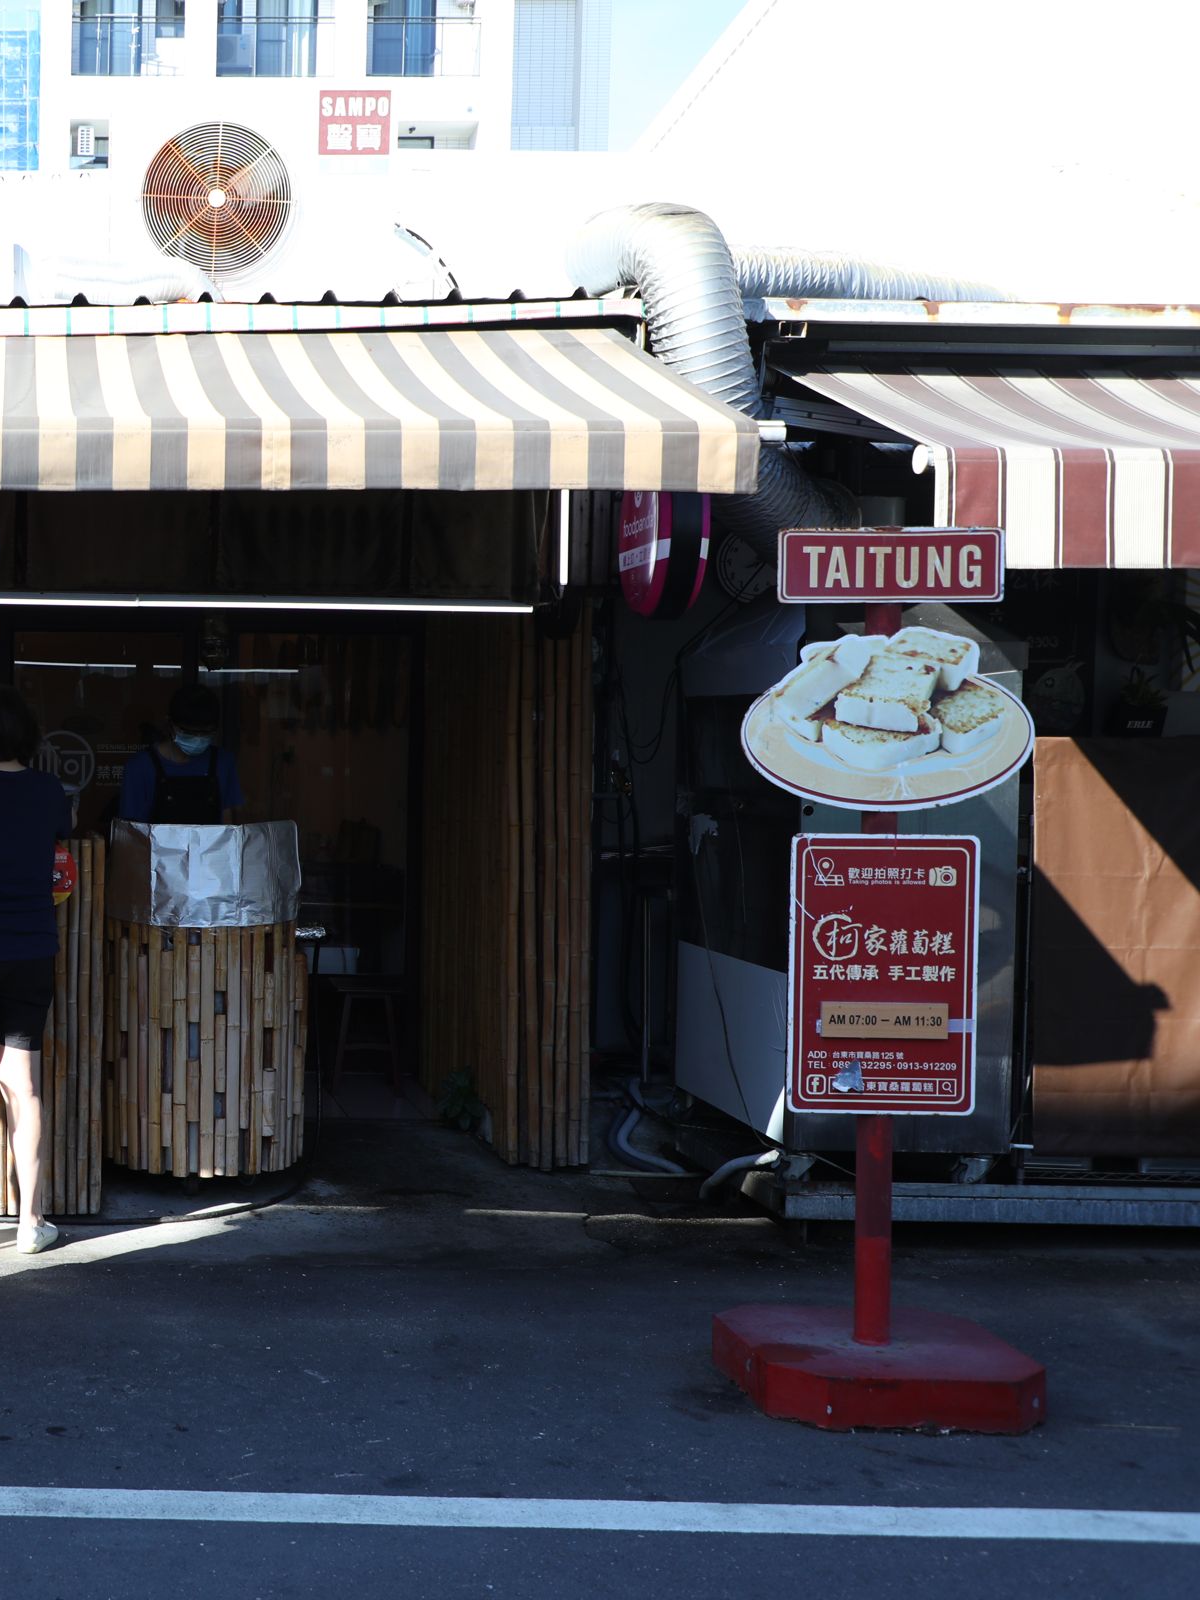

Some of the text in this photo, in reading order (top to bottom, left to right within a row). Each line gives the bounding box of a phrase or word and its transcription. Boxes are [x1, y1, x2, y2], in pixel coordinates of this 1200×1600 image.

[321, 96, 389, 117] SAMPO
[802, 544, 982, 589] TAITUNG
[848, 867, 926, 880] 歡迎拍照打卡
[812, 964, 956, 982] 五代傳承 手工製作
[829, 1015, 846, 1025] AM
[849, 1015, 877, 1025] 07:00
[894, 1016, 911, 1026] AM
[915, 1016, 942, 1027] 11:30
